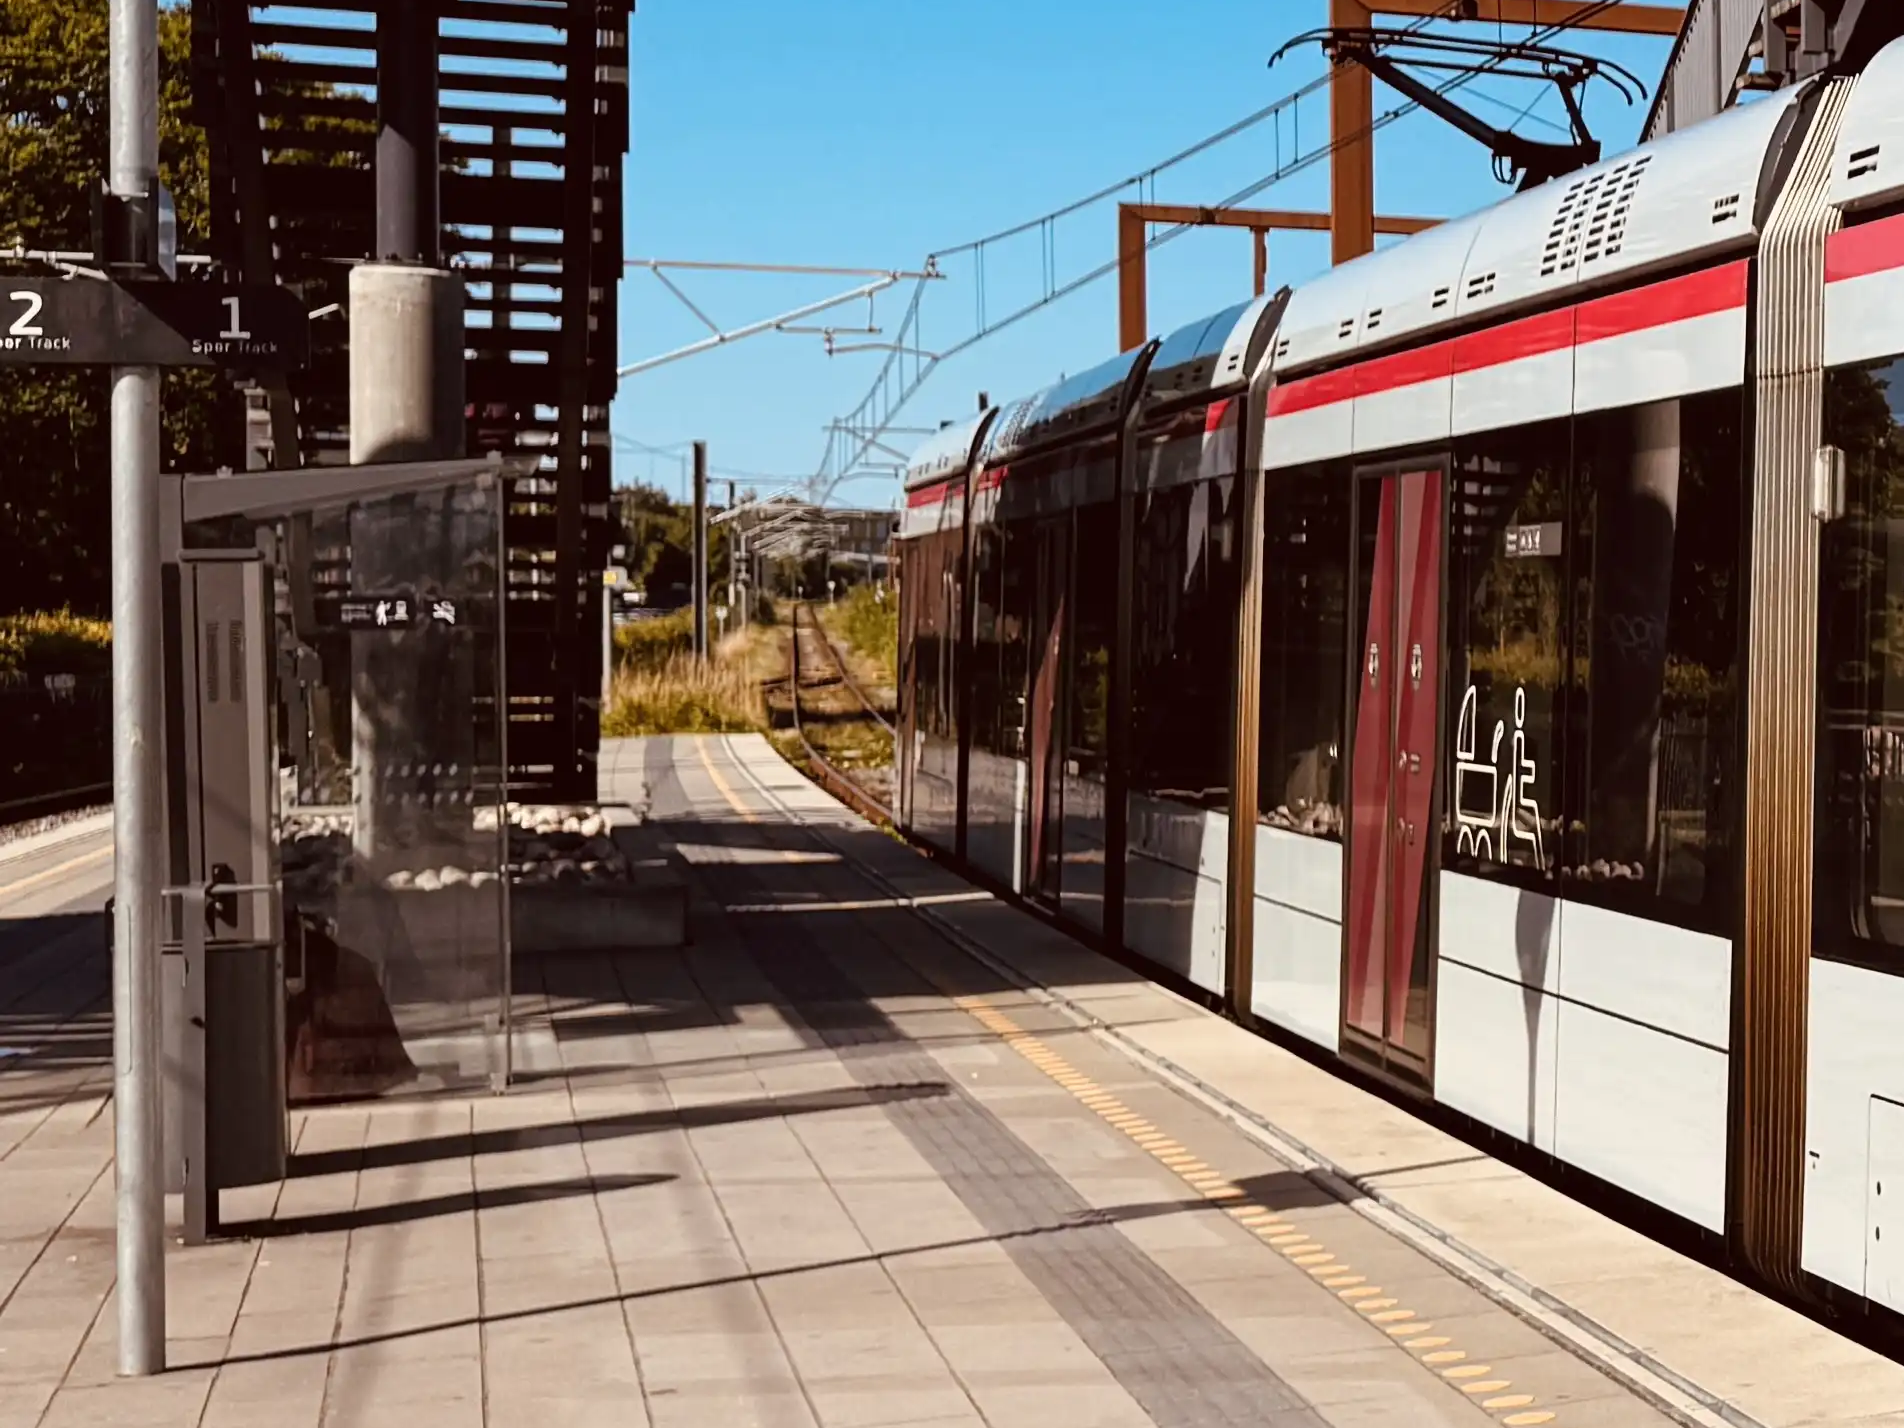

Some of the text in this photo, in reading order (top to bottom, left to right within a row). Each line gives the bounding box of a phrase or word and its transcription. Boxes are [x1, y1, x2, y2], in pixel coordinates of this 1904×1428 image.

[9, 291, 43, 336] 2
[219, 296, 251, 339] 1
[28, 336, 71, 349] Track
[192, 339, 230, 355] Spor
